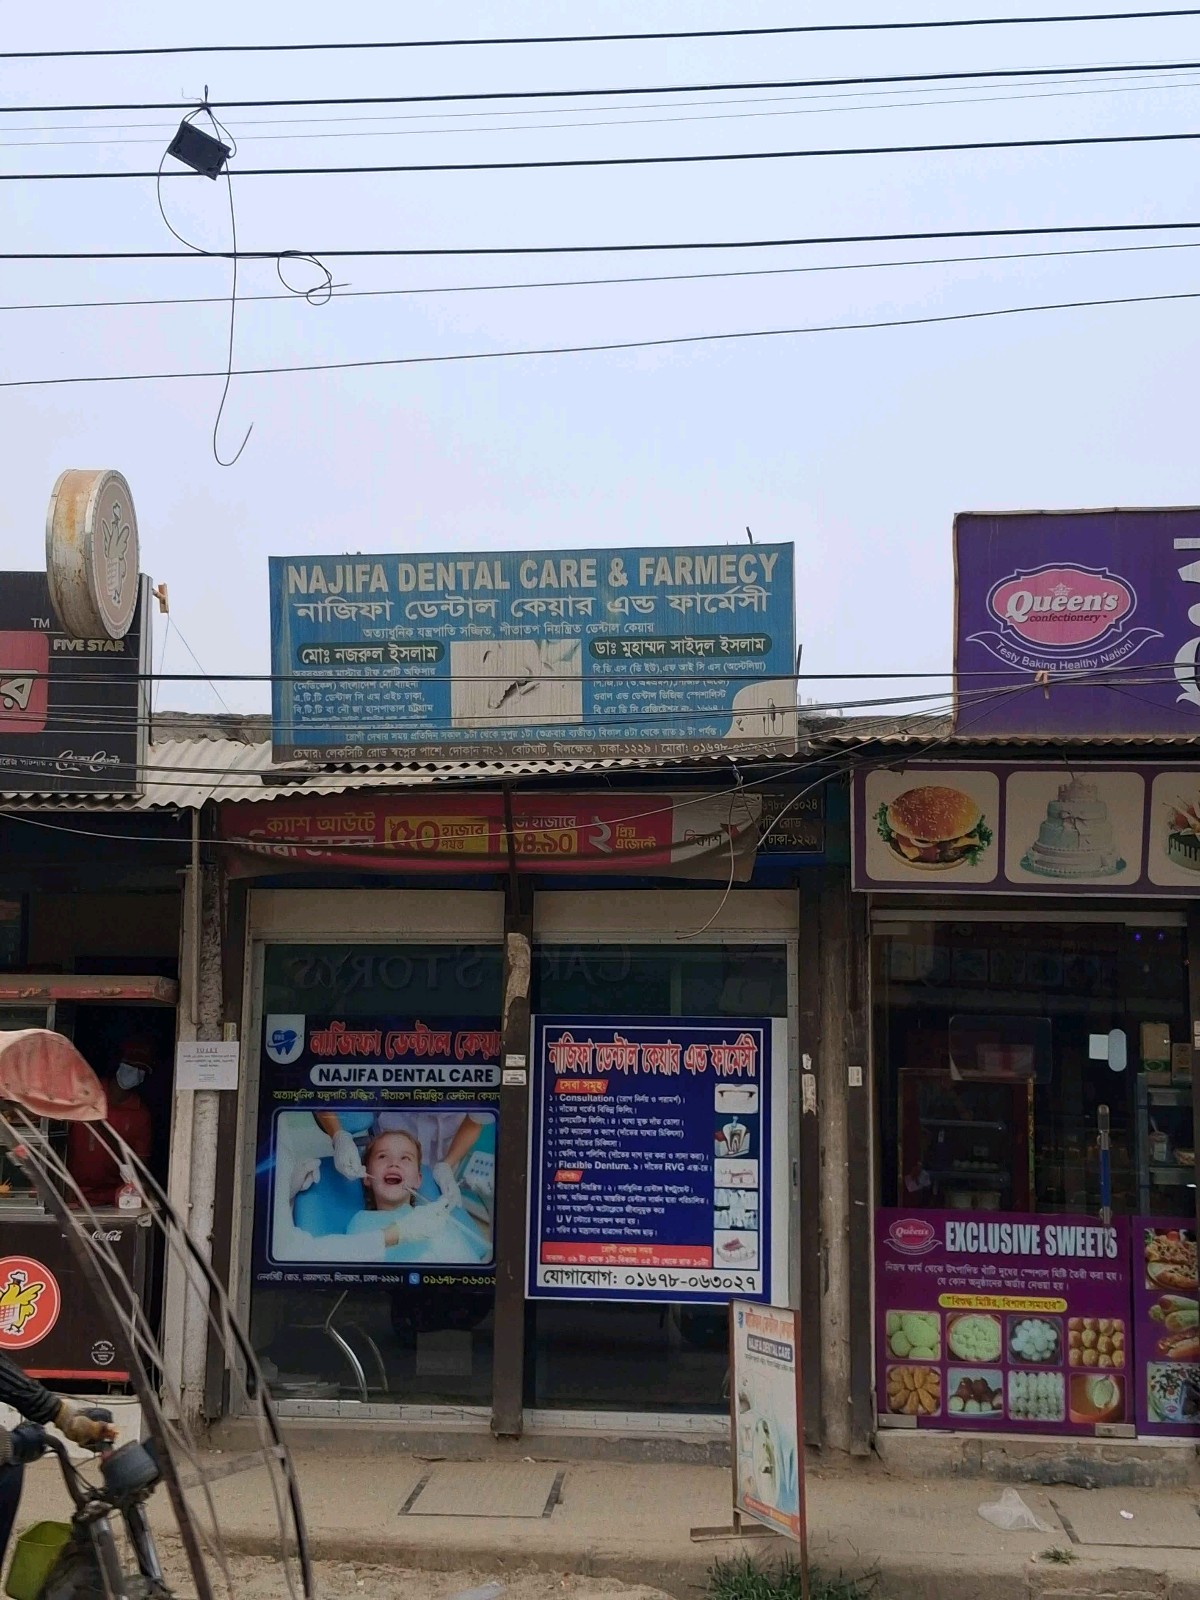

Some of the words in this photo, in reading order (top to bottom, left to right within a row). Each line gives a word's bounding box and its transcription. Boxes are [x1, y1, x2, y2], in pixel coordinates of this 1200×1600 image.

[288, 563, 389, 594] NAJIFA
[398, 560, 511, 592] DENTAL
[519, 558, 597, 589] CARE
[608, 557, 629, 588] &
[639, 552, 779, 587] FARMECY
[293, 595, 395, 624] নাজিফা
[405, 594, 500, 620] ডেন্টাল
[510, 595, 597, 617] কেয়ার
[606, 594, 659, 615] এন্ড
[665, 584, 773, 615] ফার্মেসী
[1006, 590, 1120, 624] Queen's
[31, 618, 50, 629] TM
[1029, 612, 1100, 624] confectionery
[362, 624, 414, 640] অত্যাধুনিক
[417, 624, 456, 638] যন্ত্রপাতি
[460, 624, 496, 638] সজ্জিত,
[500, 624, 541, 637] শীতাতপ
[585, 620, 620, 634] ডেন্টাল
[623, 621, 654, 634] কেয়ার
[53, 638, 85, 652] FIVE
[86, 639, 125, 652] STAR
[594, 641, 617, 656] ডাঃ
[621, 640, 667, 658] মুহাম্মদ
[670, 636, 716, 657] সাইদুল
[719, 635, 766, 654] ইসলাম
[302, 648, 331, 664] মোঃ
[334, 647, 384, 663] নজরুল
[387, 642, 438, 663] ইসলাম
[996, 642, 1018, 664] Testy
[1021, 657, 1057, 671] Baking
[1059, 657, 1099, 671] Healthy
[1100, 639, 1135, 664] Nation!
[403, 666, 436, 677] অফিসার
[614, 664, 627, 673] এস
[678, 662, 694, 672] আই
[708, 662, 721, 672] এস
[325, 692, 352, 702] ডেন্টাল
[631, 690, 657, 701] ডেন্টাল
[365, 704, 405, 714] হাসপাতাল
[410, 730, 438, 742] প্রতিদিন
[480, 730, 499, 740] থেকে
[325, 745, 364, 759] লেকসিটি
[367, 746, 387, 757] রোড
[449, 745, 479, 757] দোকান
[267, 817, 311, 833] ক্যাশ
[316, 812, 376, 833] আউটে
[588, 815, 612, 854] ২
[615, 825, 637, 841] প্রিয়
[310, 1020, 382, 1057] নাজিফা
[385, 1019, 452, 1061] ডেন্টাল
[548, 1031, 594, 1075] নাজিফা
[595, 1032, 640, 1076] ডেন্টাল
[640, 1039, 682, 1077] কেয়ার
[710, 1033, 758, 1078] ফার্মেসী
[318, 1068, 378, 1083] NAJIFA
[382, 1068, 445, 1083] DENTAL
[449, 1068, 494, 1083] CARE
[559, 1080, 580, 1092] সেবা
[272, 1088, 315, 1102] অত্যাধুনিক
[446, 1088, 475, 1101] ডেন্টাল
[559, 1093, 615, 1103] Consultation
[558, 1161, 592, 1170] Flexible
[664, 1162, 685, 1171] RVG
[945, 1220, 1041, 1256] EXCLUSIVE
[1045, 1223, 1118, 1259] SWEETS
[624, 1273, 756, 1291] ০১৬৭৮-০৬৩০২৭
[1003, 1297, 1028, 1309] বিশাল
